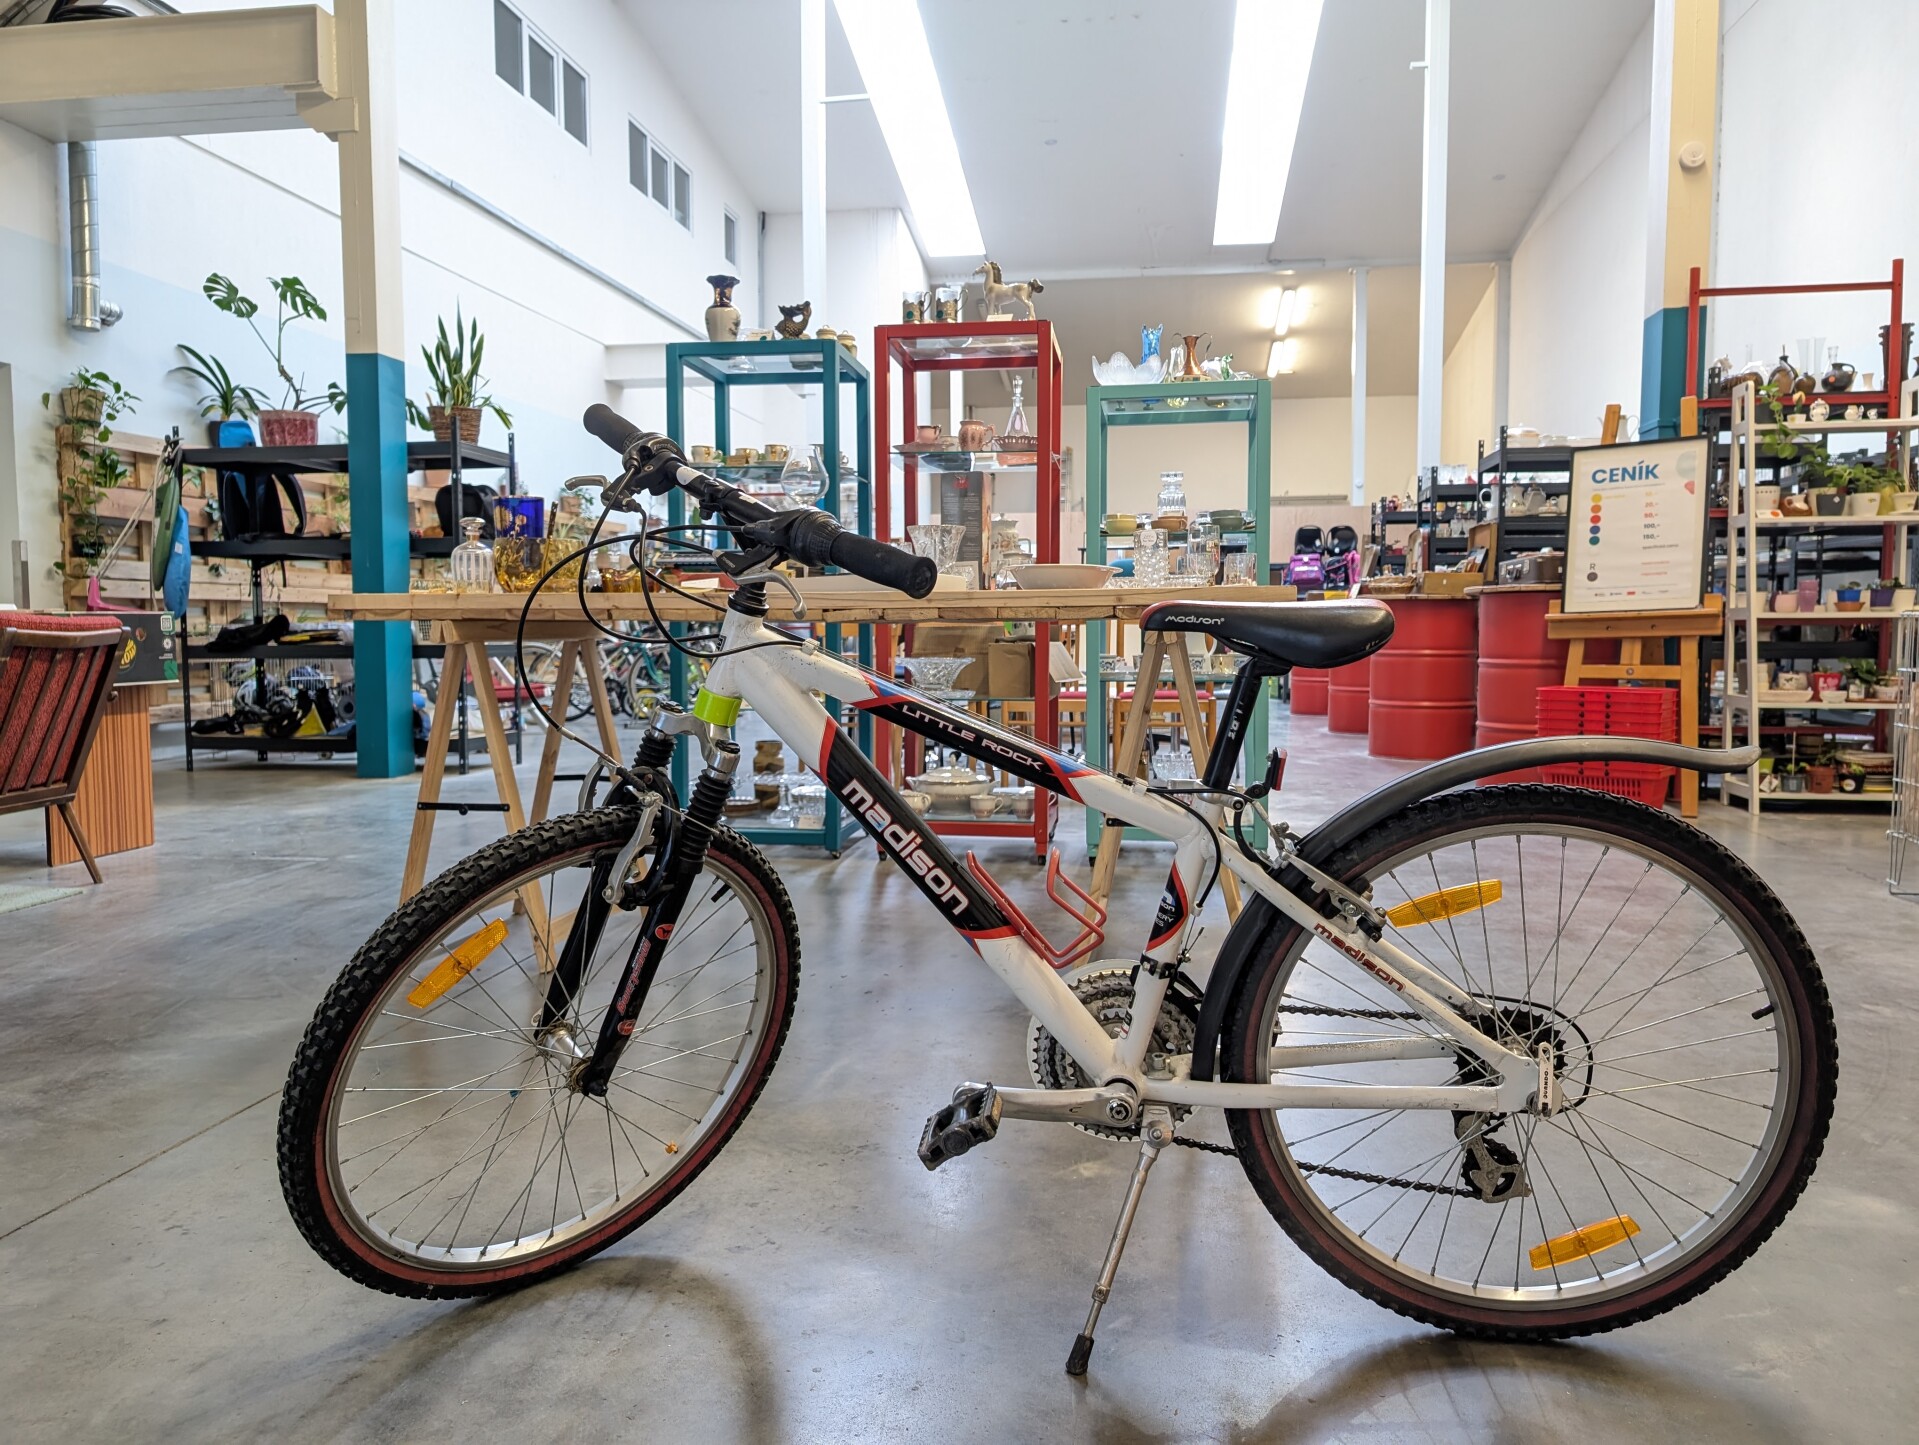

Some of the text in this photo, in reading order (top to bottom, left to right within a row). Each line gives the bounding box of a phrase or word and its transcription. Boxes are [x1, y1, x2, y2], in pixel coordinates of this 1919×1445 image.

[1591, 460, 1660, 484] CENÍK
[902, 704, 1044, 771] LITTLE ROCK
[841, 778, 970, 916] madison
[1314, 922, 1406, 992] madison
